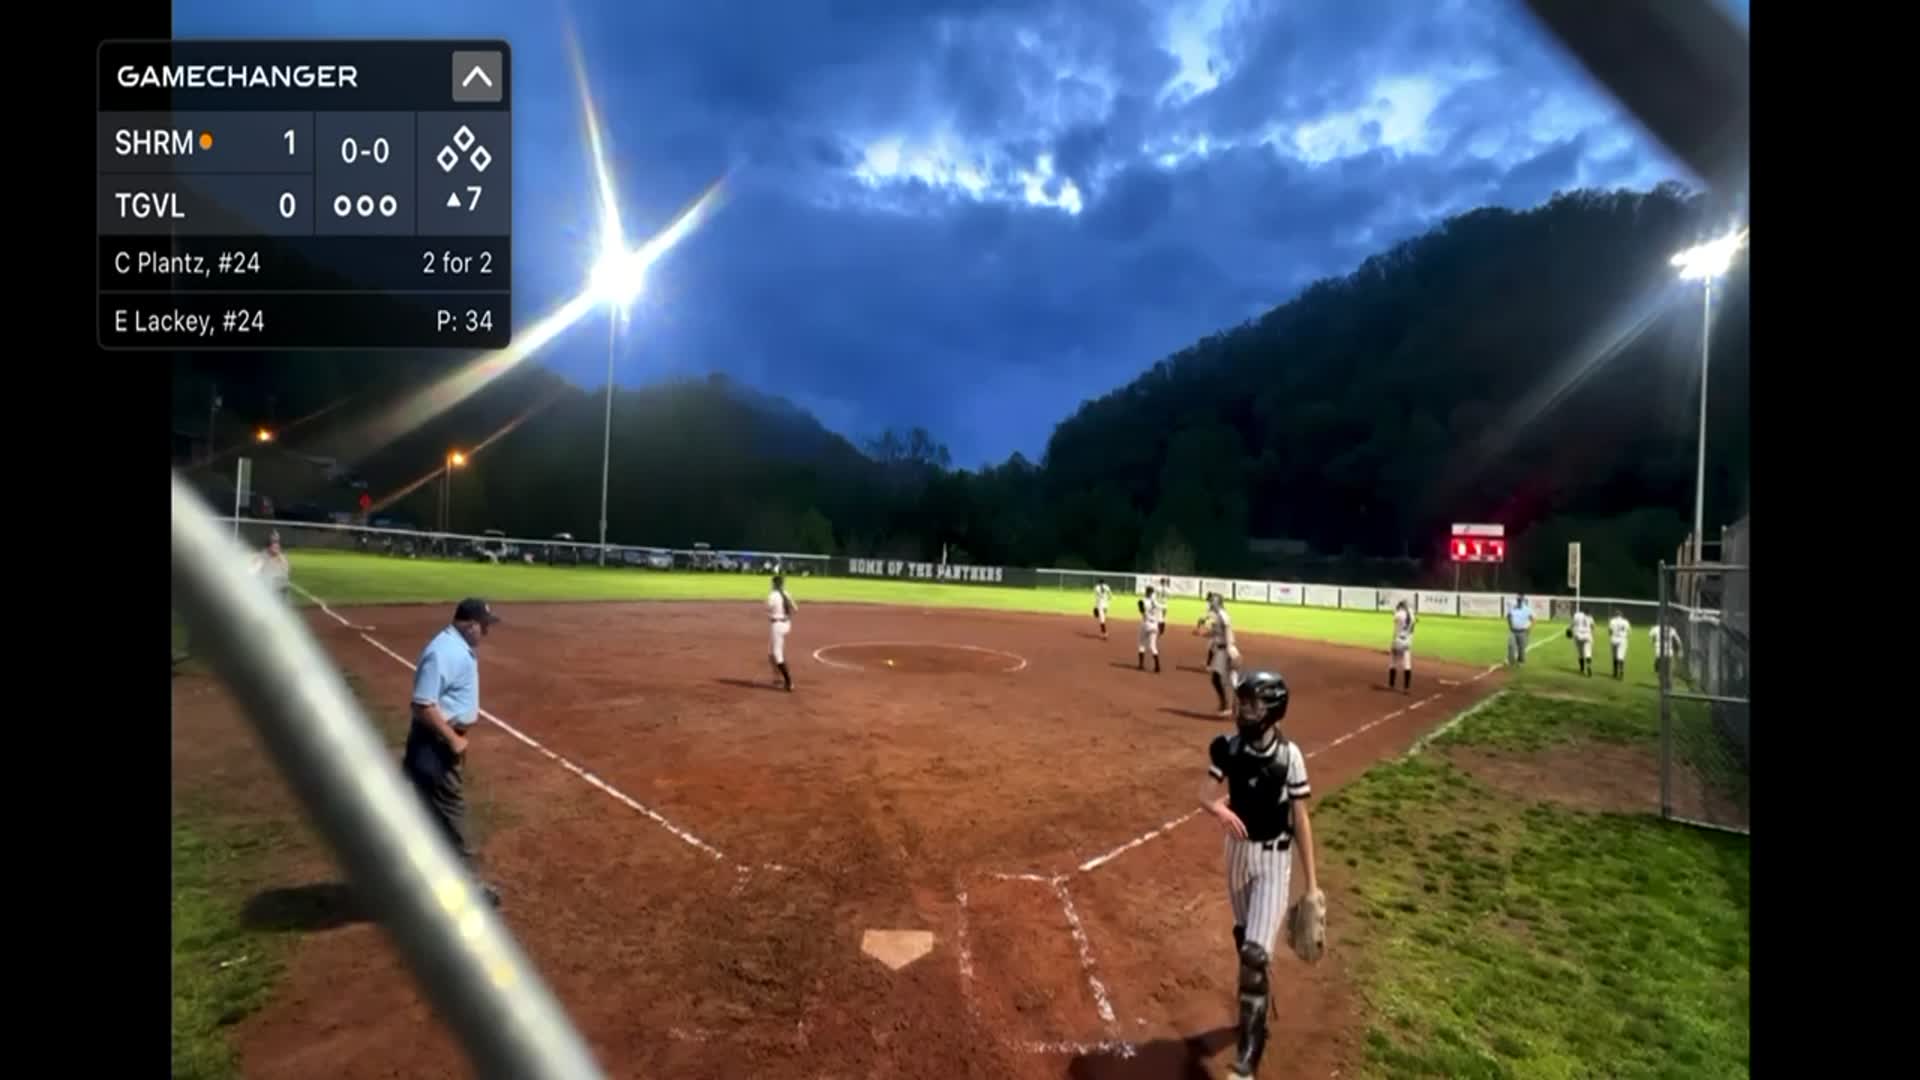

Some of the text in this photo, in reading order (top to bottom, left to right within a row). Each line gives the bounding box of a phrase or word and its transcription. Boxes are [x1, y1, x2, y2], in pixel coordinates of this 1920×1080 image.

[849, 558, 1003, 582] HOME OF THE PANTHERS
